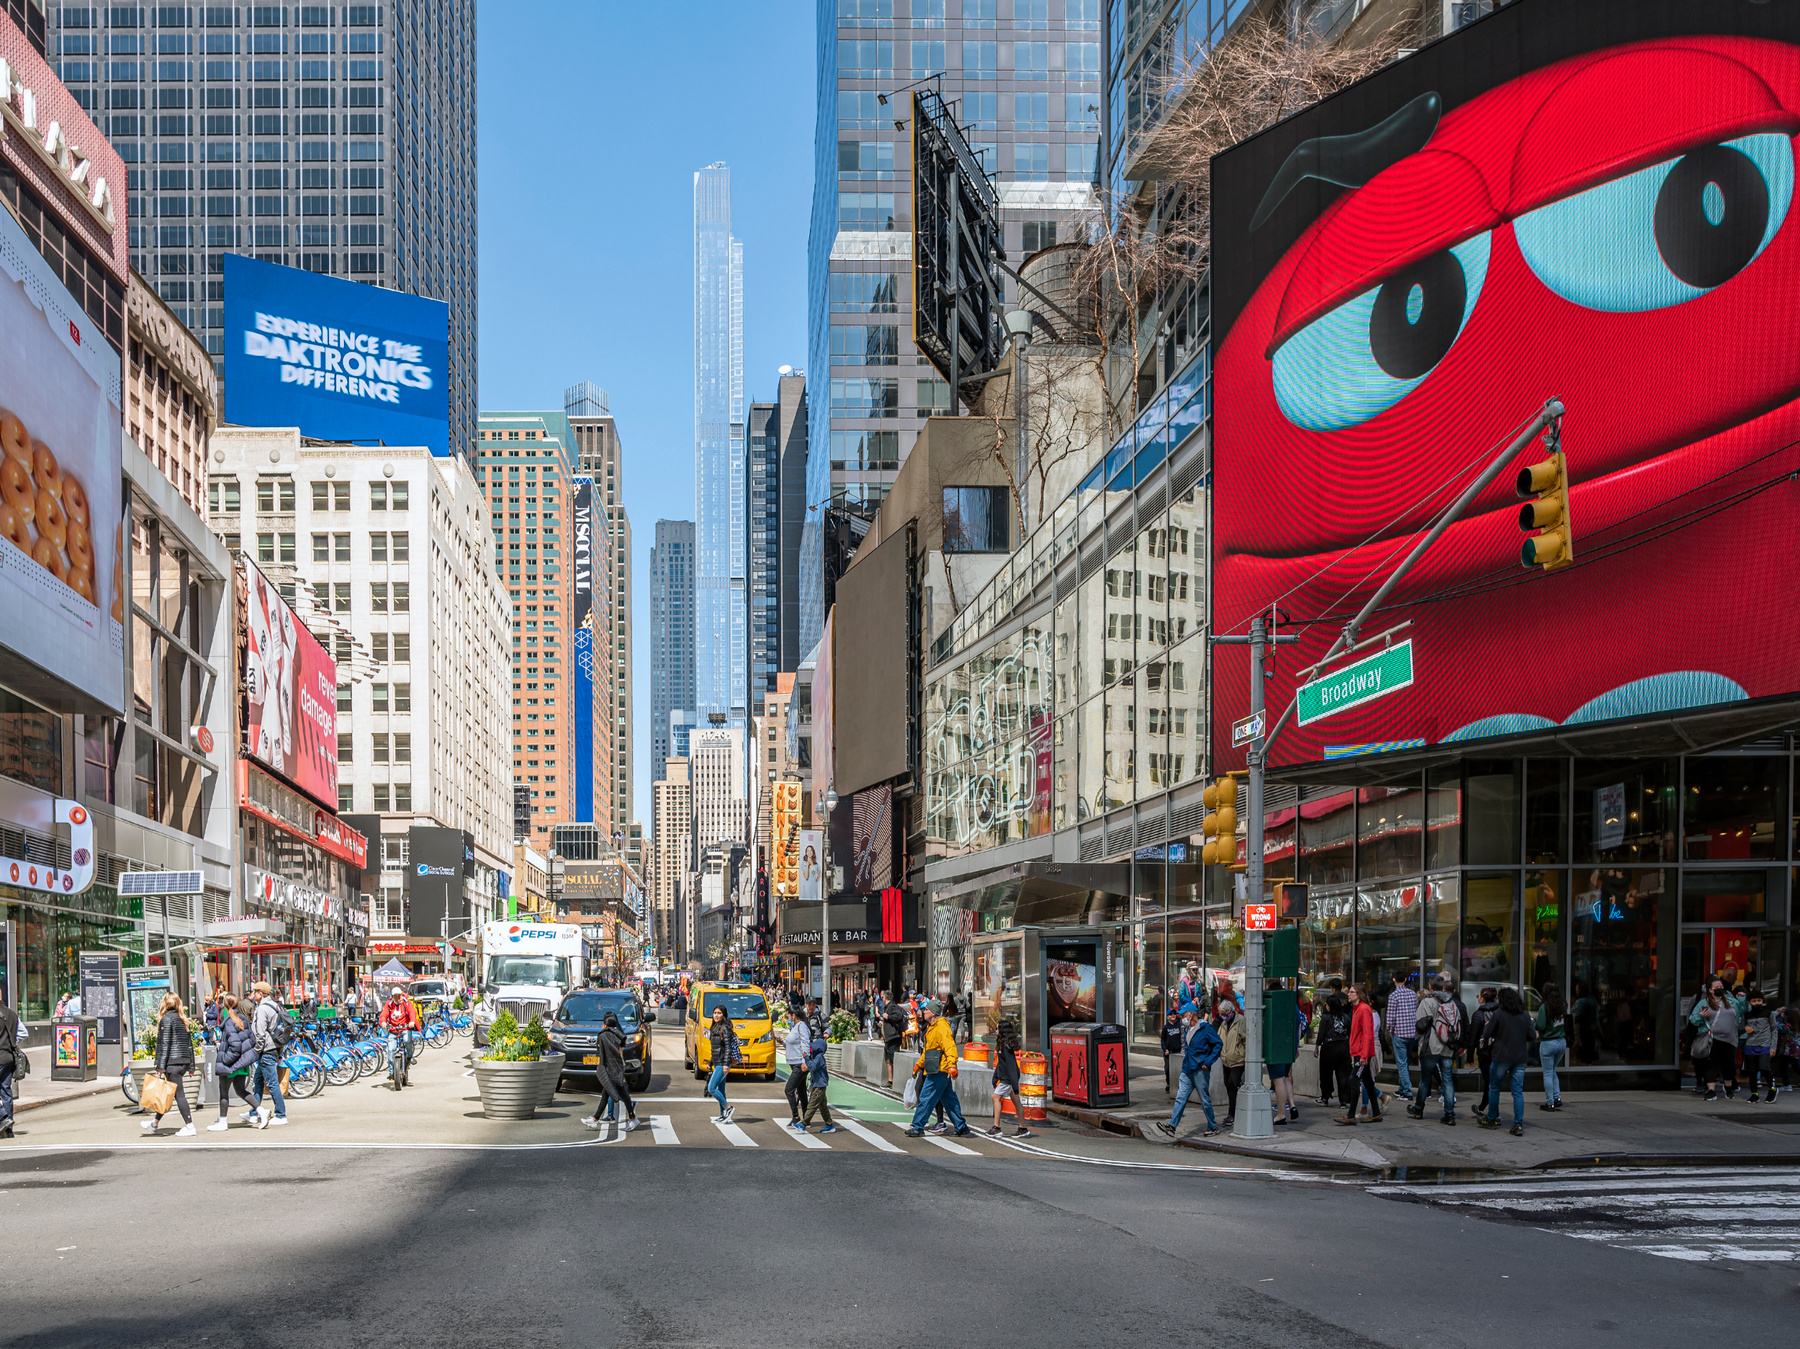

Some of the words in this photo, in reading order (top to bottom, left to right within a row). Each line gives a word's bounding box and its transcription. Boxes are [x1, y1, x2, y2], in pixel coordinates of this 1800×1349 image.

[254, 310, 379, 355] EXPERIENCE
[382, 339, 422, 362] THE
[244, 330, 433, 390] DAKTRONICS
[280, 364, 400, 403] DIFFERENCE
[1321, 667, 1382, 706] Broadway
[301, 683, 332, 737] damage
[1237, 725, 1247, 738] ONE
[1250, 719, 1261, 733] WAY
[239, 913, 258, 921] PLAZA
[1251, 913, 1271, 921] WRONG
[521, 929, 556, 939] PEPSI
[832, 931, 839, 941] &
[846, 930, 867, 941] BAR
[383, 943, 404, 952] CVS
[404, 945, 440, 953] pharmacy
